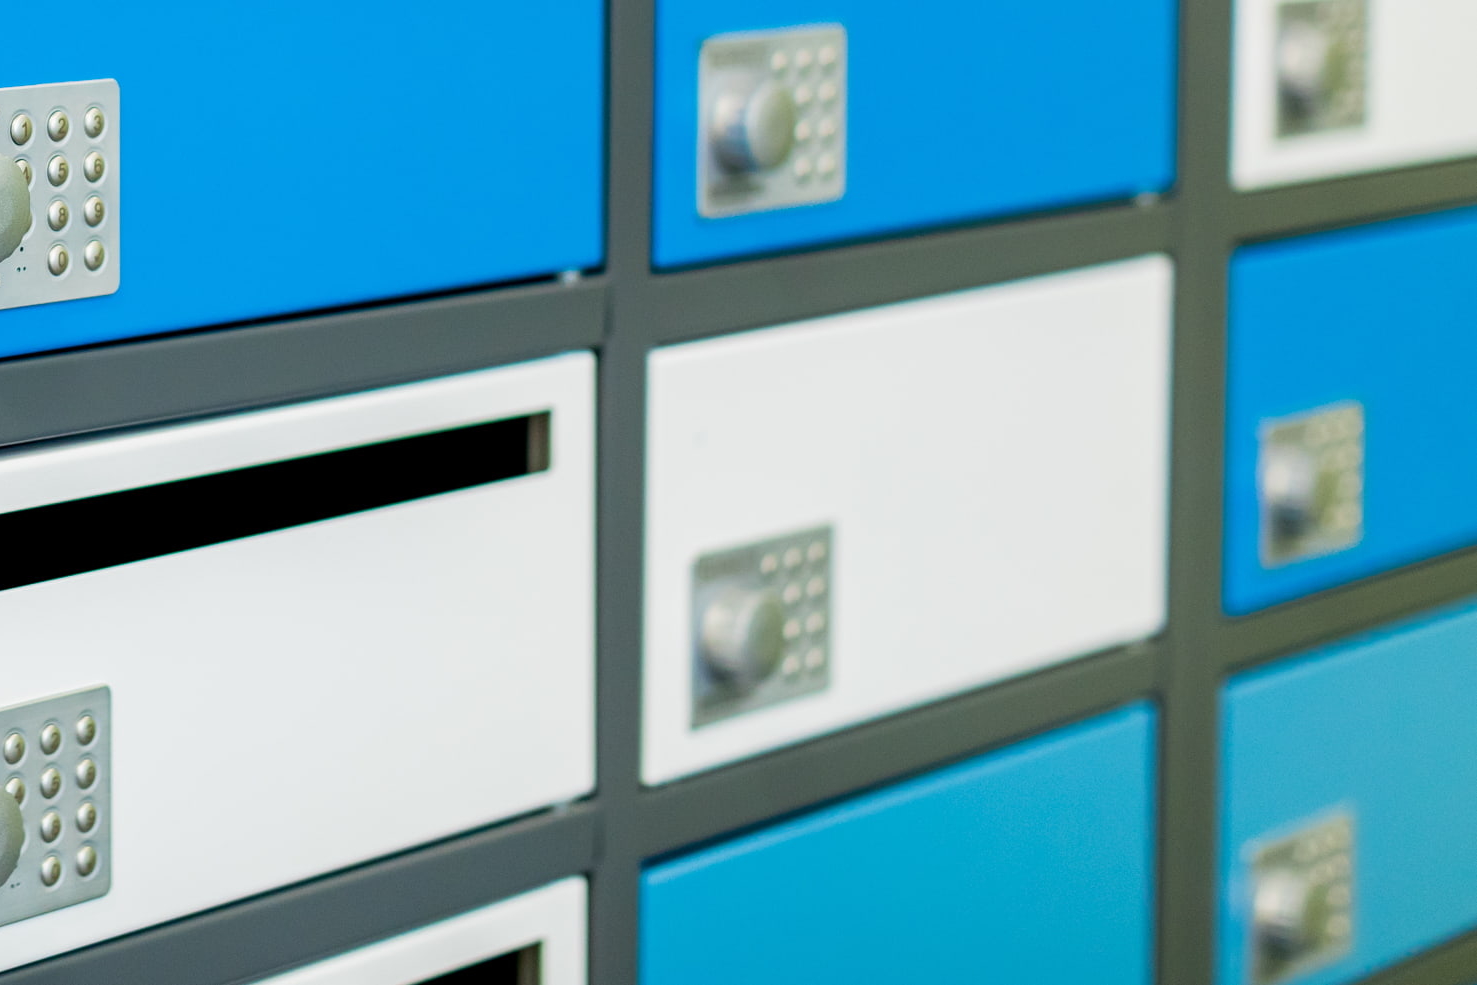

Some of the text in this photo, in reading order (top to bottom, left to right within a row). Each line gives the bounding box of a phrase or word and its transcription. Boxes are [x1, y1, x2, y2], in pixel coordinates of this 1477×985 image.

[22, 115, 101, 137] 1 2 3
[58, 162, 66, 178] 5
[93, 158, 101, 174] 6
[58, 202, 101, 224] 8 9
[58, 251, 66, 268] 0
